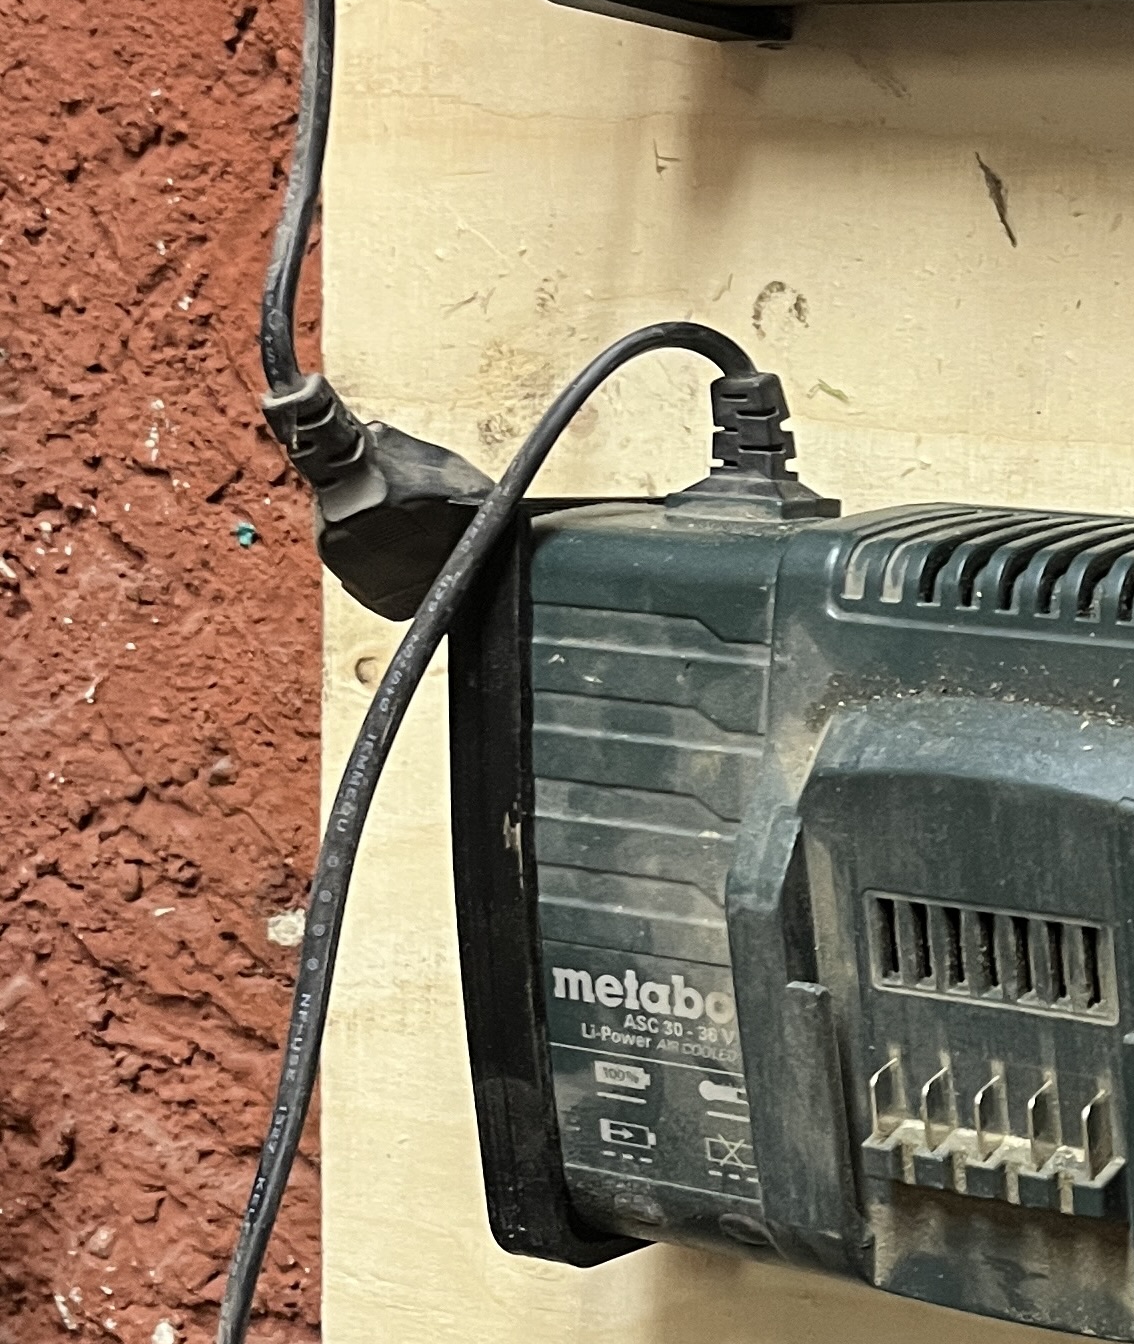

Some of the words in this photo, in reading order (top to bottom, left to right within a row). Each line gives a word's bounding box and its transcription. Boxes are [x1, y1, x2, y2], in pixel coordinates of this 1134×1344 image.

[552, 967, 736, 1024] metabo
[581, 1022, 652, 1049] Li-Power
[655, 1038, 681, 1054] AIR
[623, 1014, 660, 1035] ASC
[663, 1020, 684, 1037] 30
[720, 1027, 736, 1045] V
[602, 1065, 641, 1084] 100%
